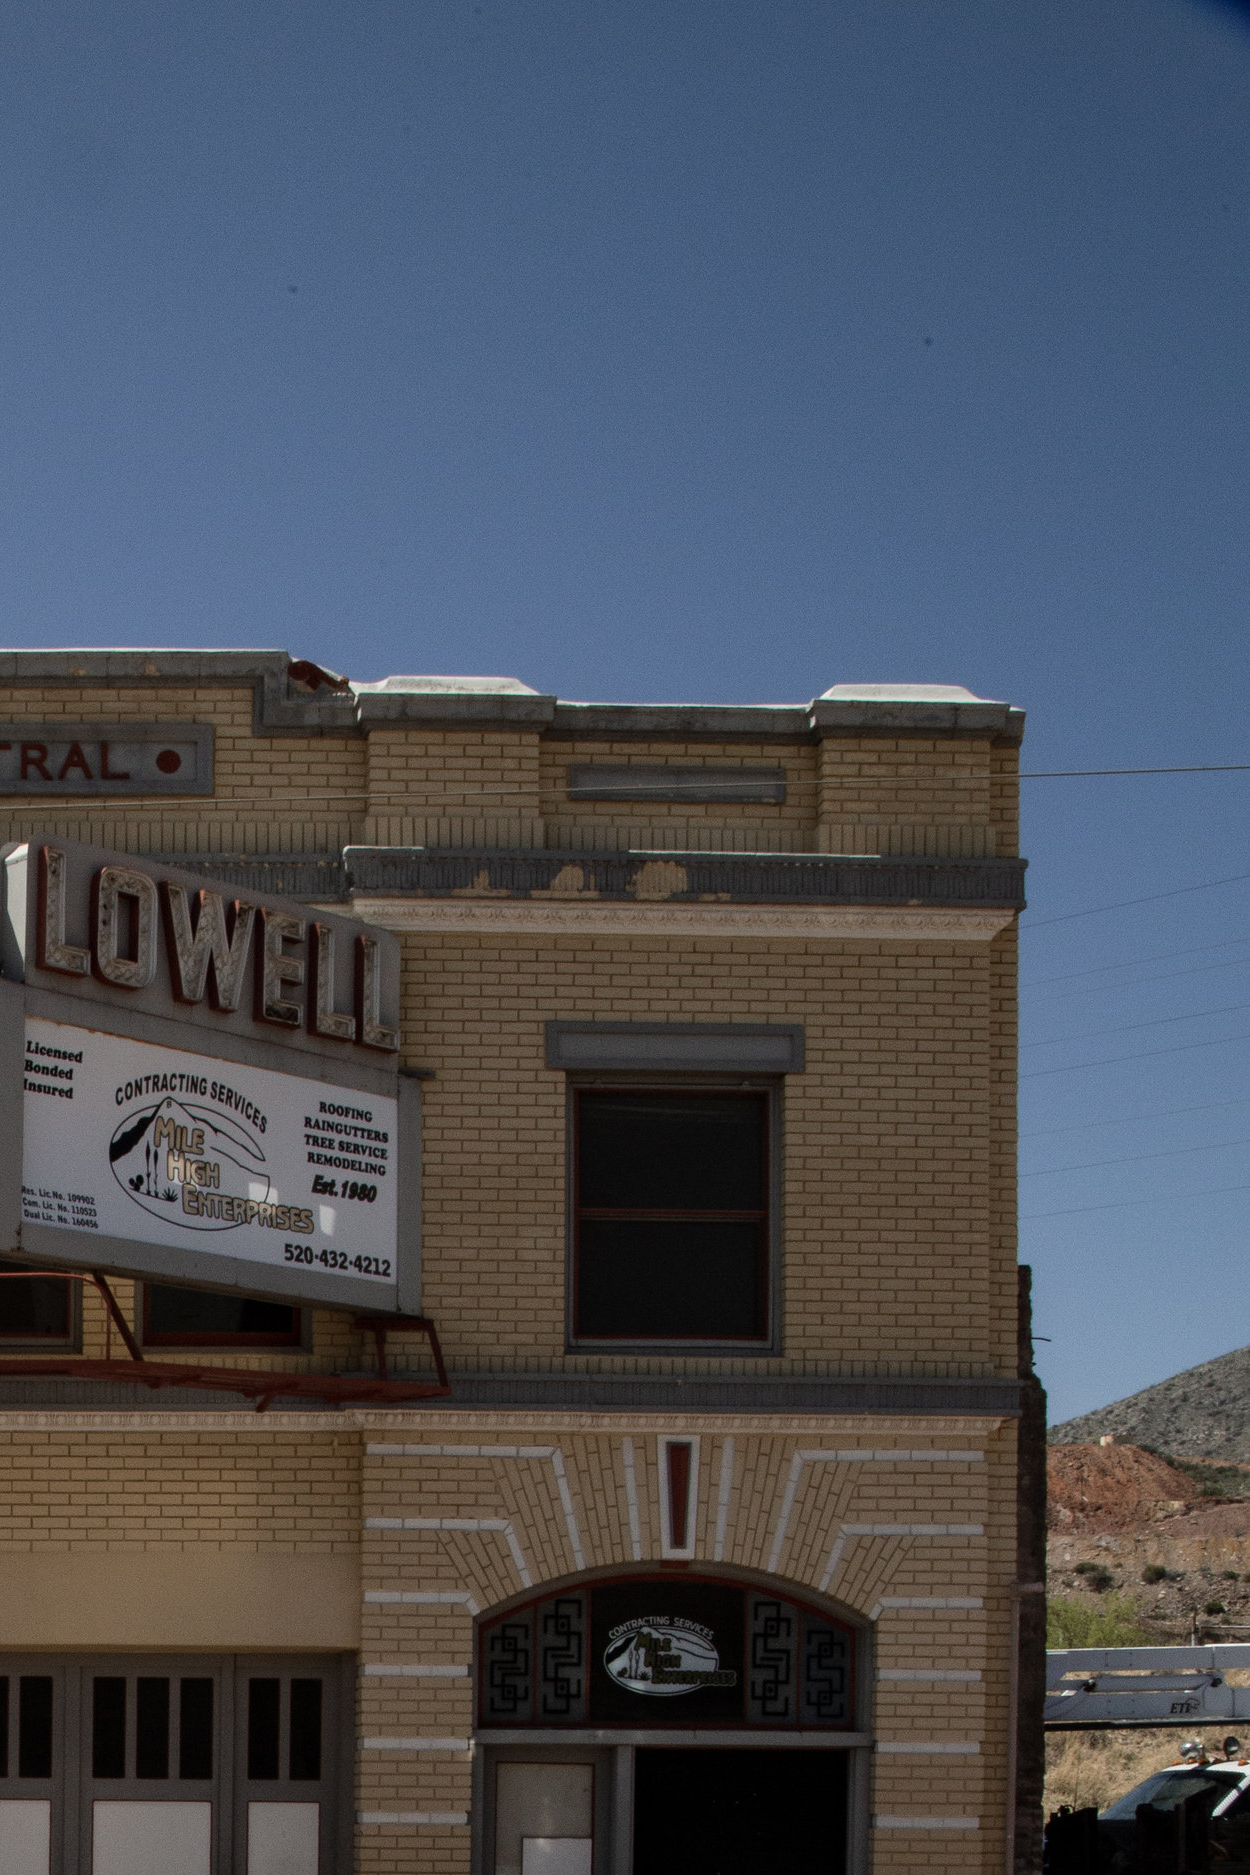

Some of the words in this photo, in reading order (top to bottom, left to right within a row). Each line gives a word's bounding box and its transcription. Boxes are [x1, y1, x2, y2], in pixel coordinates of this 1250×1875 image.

[36, 845, 399, 1053] LOWELL
[25, 1040, 83, 1064] Licensed
[24, 1060, 74, 1081] Bonded
[23, 1078, 74, 1099] Insured
[114, 1074, 208, 1108] CONTRACTING
[209, 1080, 268, 1134] SERVICES
[318, 1101, 373, 1123] ROOFING
[154, 1117, 205, 1155] MILE
[303, 1116, 389, 1144] RAINGUTTERS
[304, 1134, 335, 1153] TREE
[336, 1139, 389, 1161] SERVICE
[166, 1150, 220, 1188] HIGH
[306, 1151, 387, 1177] REMODELING
[311, 1174, 338, 1198] Est.
[340, 1179, 377, 1203] 1980
[182, 1184, 315, 1235] ENTERPRISES
[608, 1615, 671, 1639] CONTRACTING
[673, 1616, 715, 1640] SERVICES
